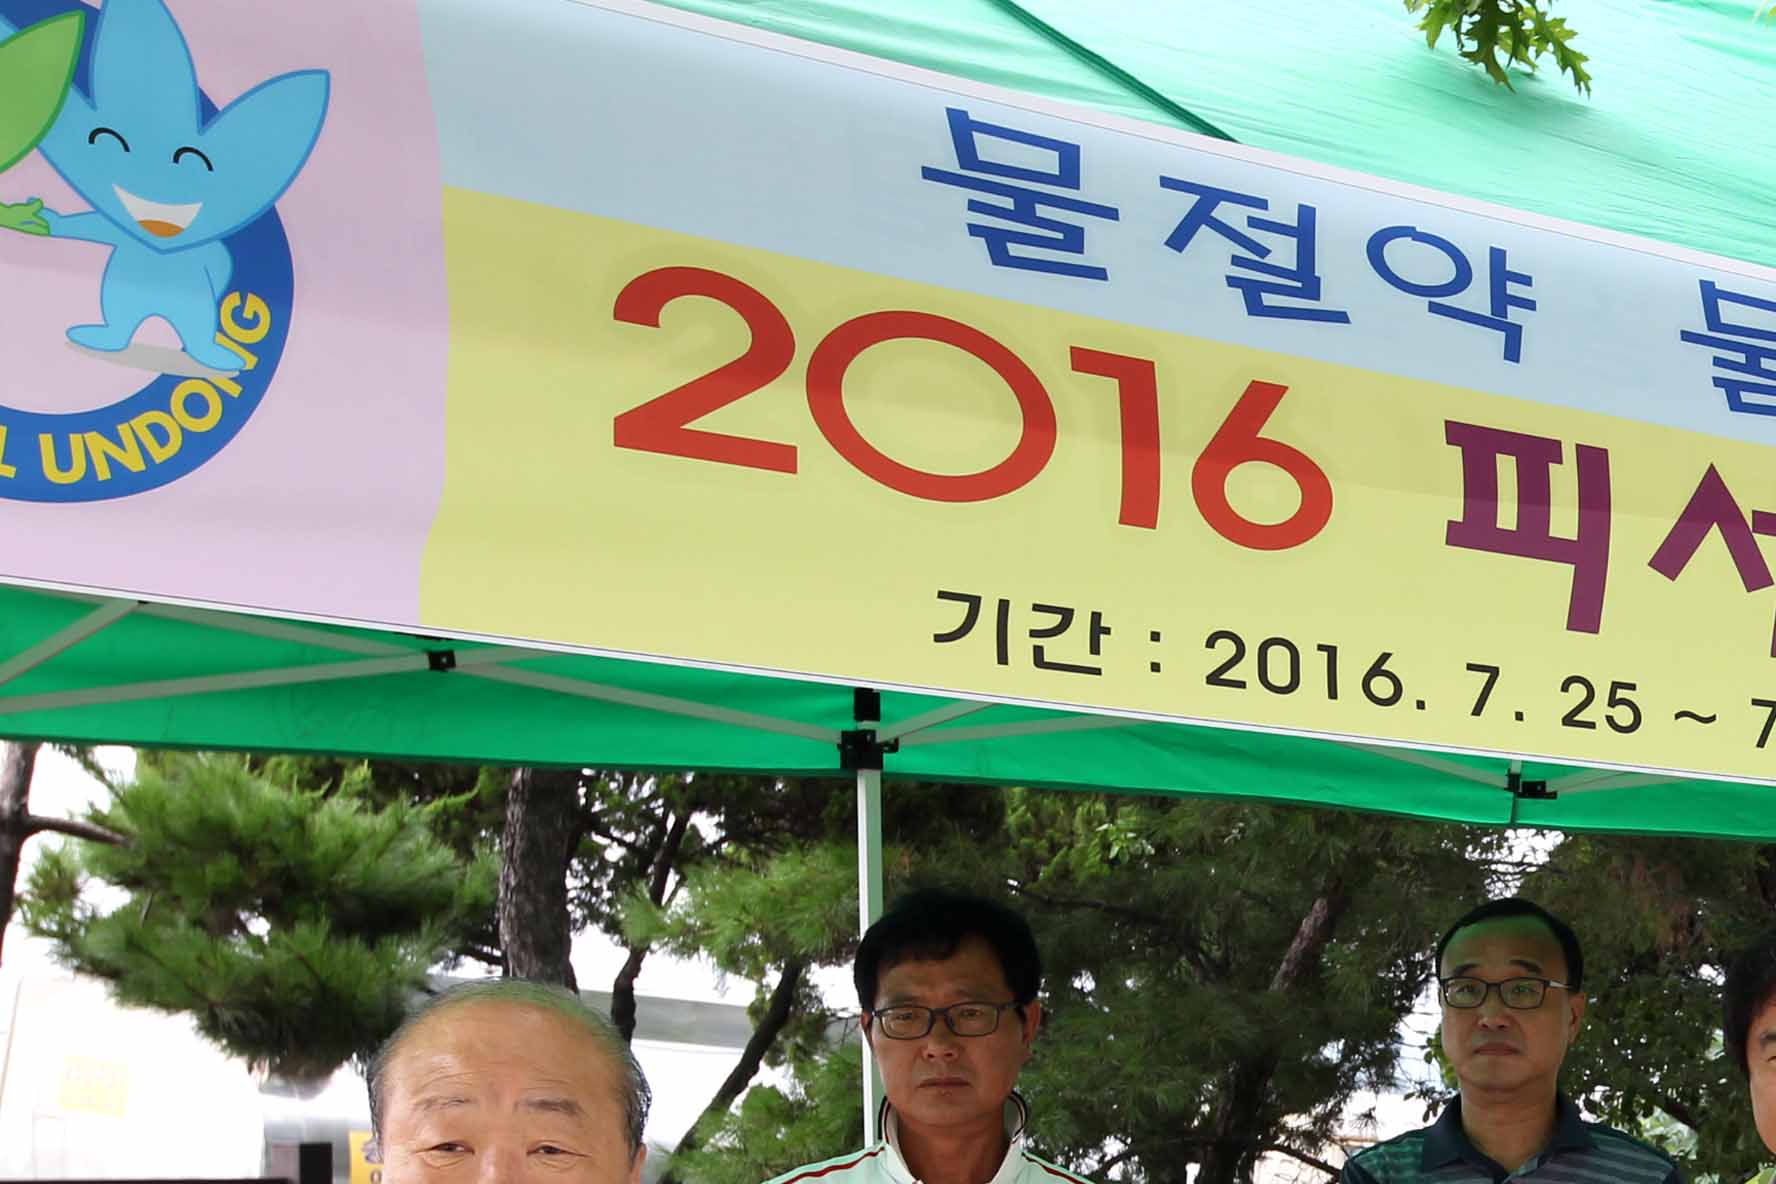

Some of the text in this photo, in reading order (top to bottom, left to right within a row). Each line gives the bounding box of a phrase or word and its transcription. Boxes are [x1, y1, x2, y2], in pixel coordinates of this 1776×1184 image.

[921, 107, 1537, 364] 물절약
[613, 265, 1334, 551] 2016
[933, 590, 1111, 677] 기간
